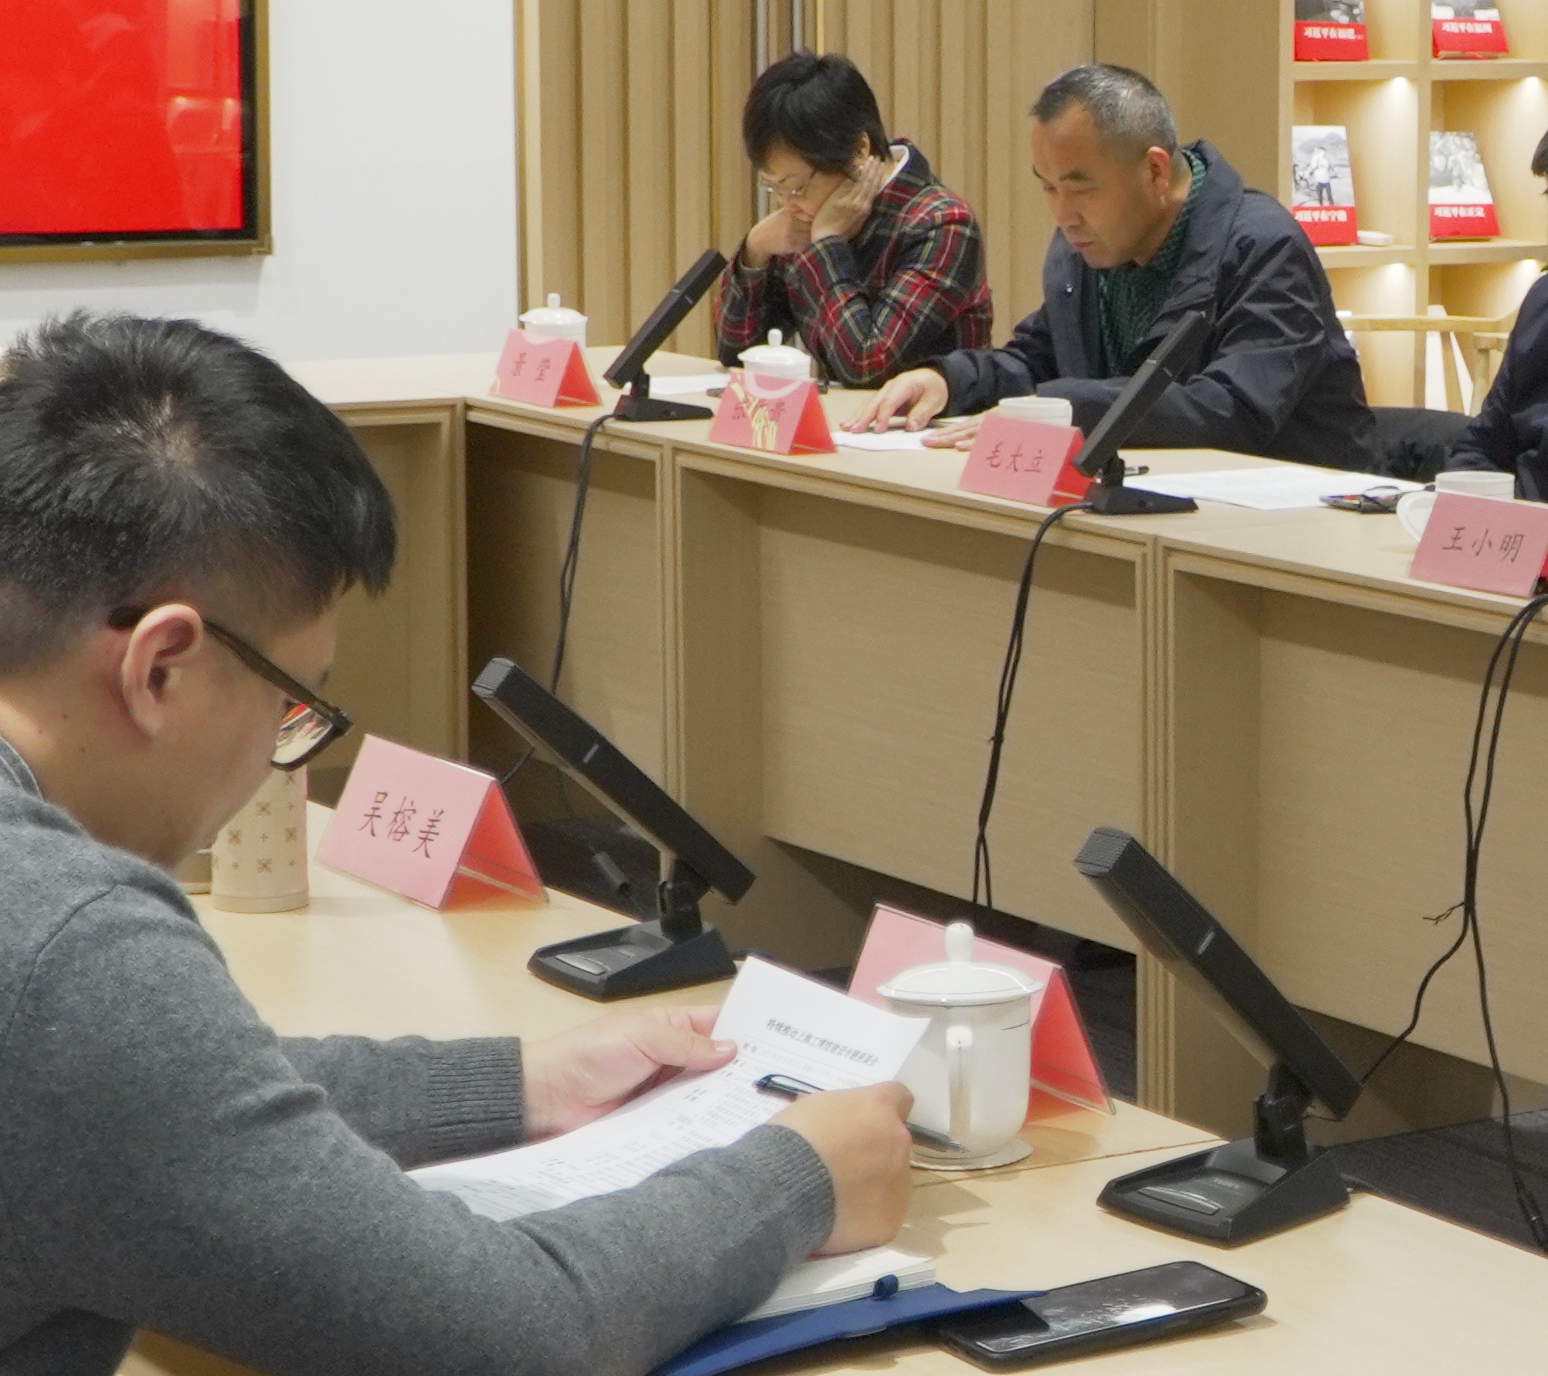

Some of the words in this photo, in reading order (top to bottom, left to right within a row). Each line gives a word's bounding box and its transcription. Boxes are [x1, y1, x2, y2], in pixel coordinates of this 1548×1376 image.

[986, 440, 1044, 473] 毛大立
[1441, 525, 1526, 564] 王小明
